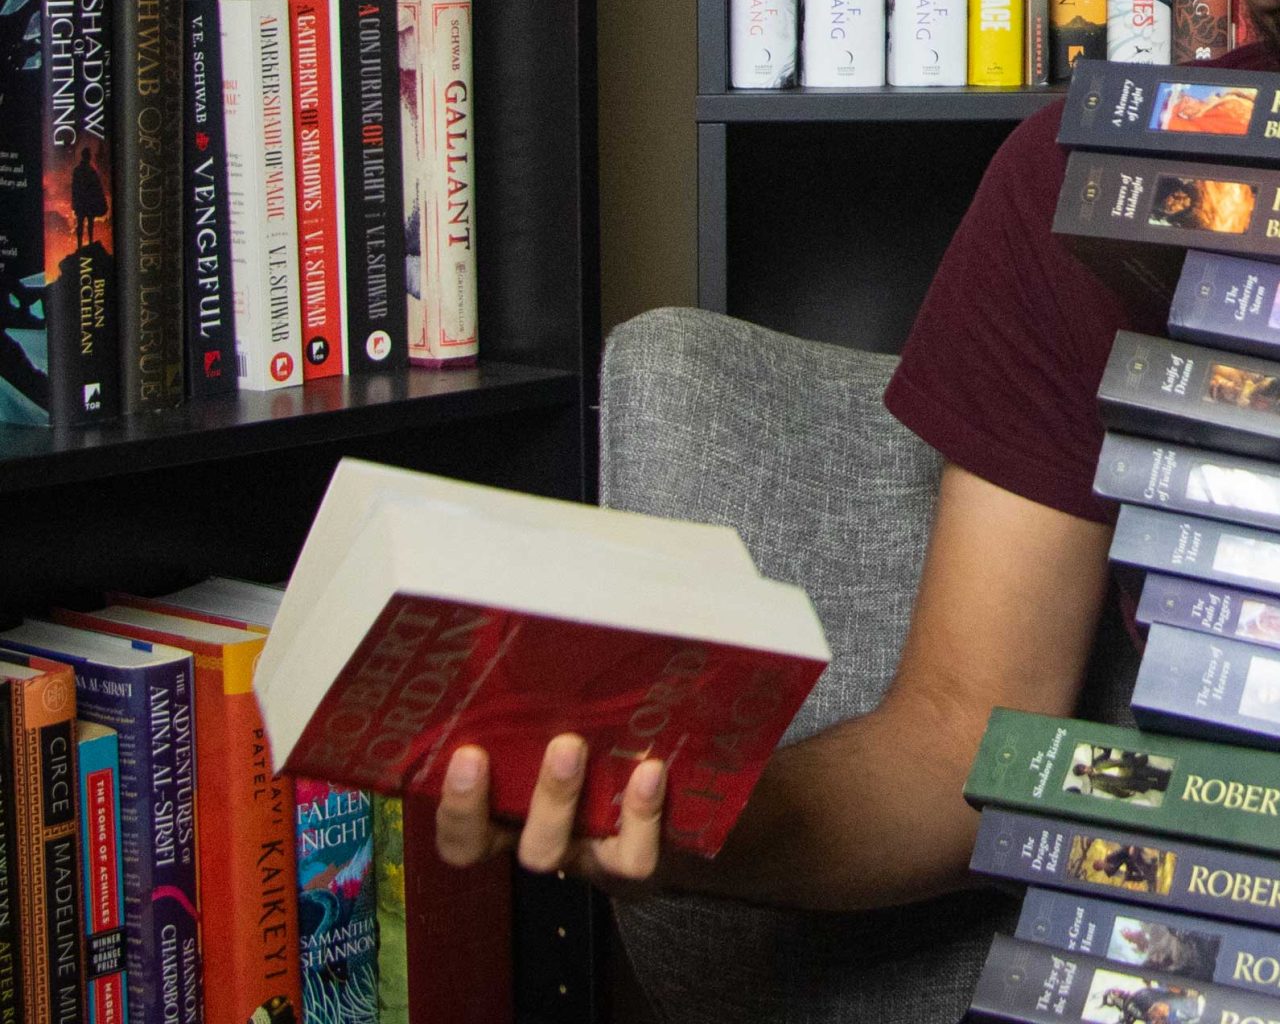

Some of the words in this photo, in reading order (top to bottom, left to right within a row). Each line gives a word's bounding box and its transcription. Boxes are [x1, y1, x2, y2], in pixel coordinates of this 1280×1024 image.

[46, 0, 77, 146] LIGHTNING
[193, 52, 206, 123] SCHWAB
[443, 80, 471, 250] GALLANT
[194, 157, 221, 337] VENGEFUL
[80, 256, 92, 354] MCCLELLAN
[93, 279, 105, 328] BRIAN
[150, 685, 171, 757] AMINA
[50, 736, 70, 815] CIRCE
[96, 780, 104, 805] THE
[173, 703, 194, 843] ADVENTURES
[252, 729, 264, 801] PATEL
[98, 807, 107, 842] SONG
[152, 764, 176, 868] AL-SIRAFI
[297, 791, 370, 825] FALLEN
[301, 821, 368, 852] NIGHT
[100, 844, 108, 861] OF
[53, 841, 76, 977] MADELINE
[100, 864, 109, 925] ACHILLES
[257, 842, 290, 981] KAIKEYI
[300, 918, 376, 950] SAMANTHA
[300, 936, 377, 969] SHANNON
